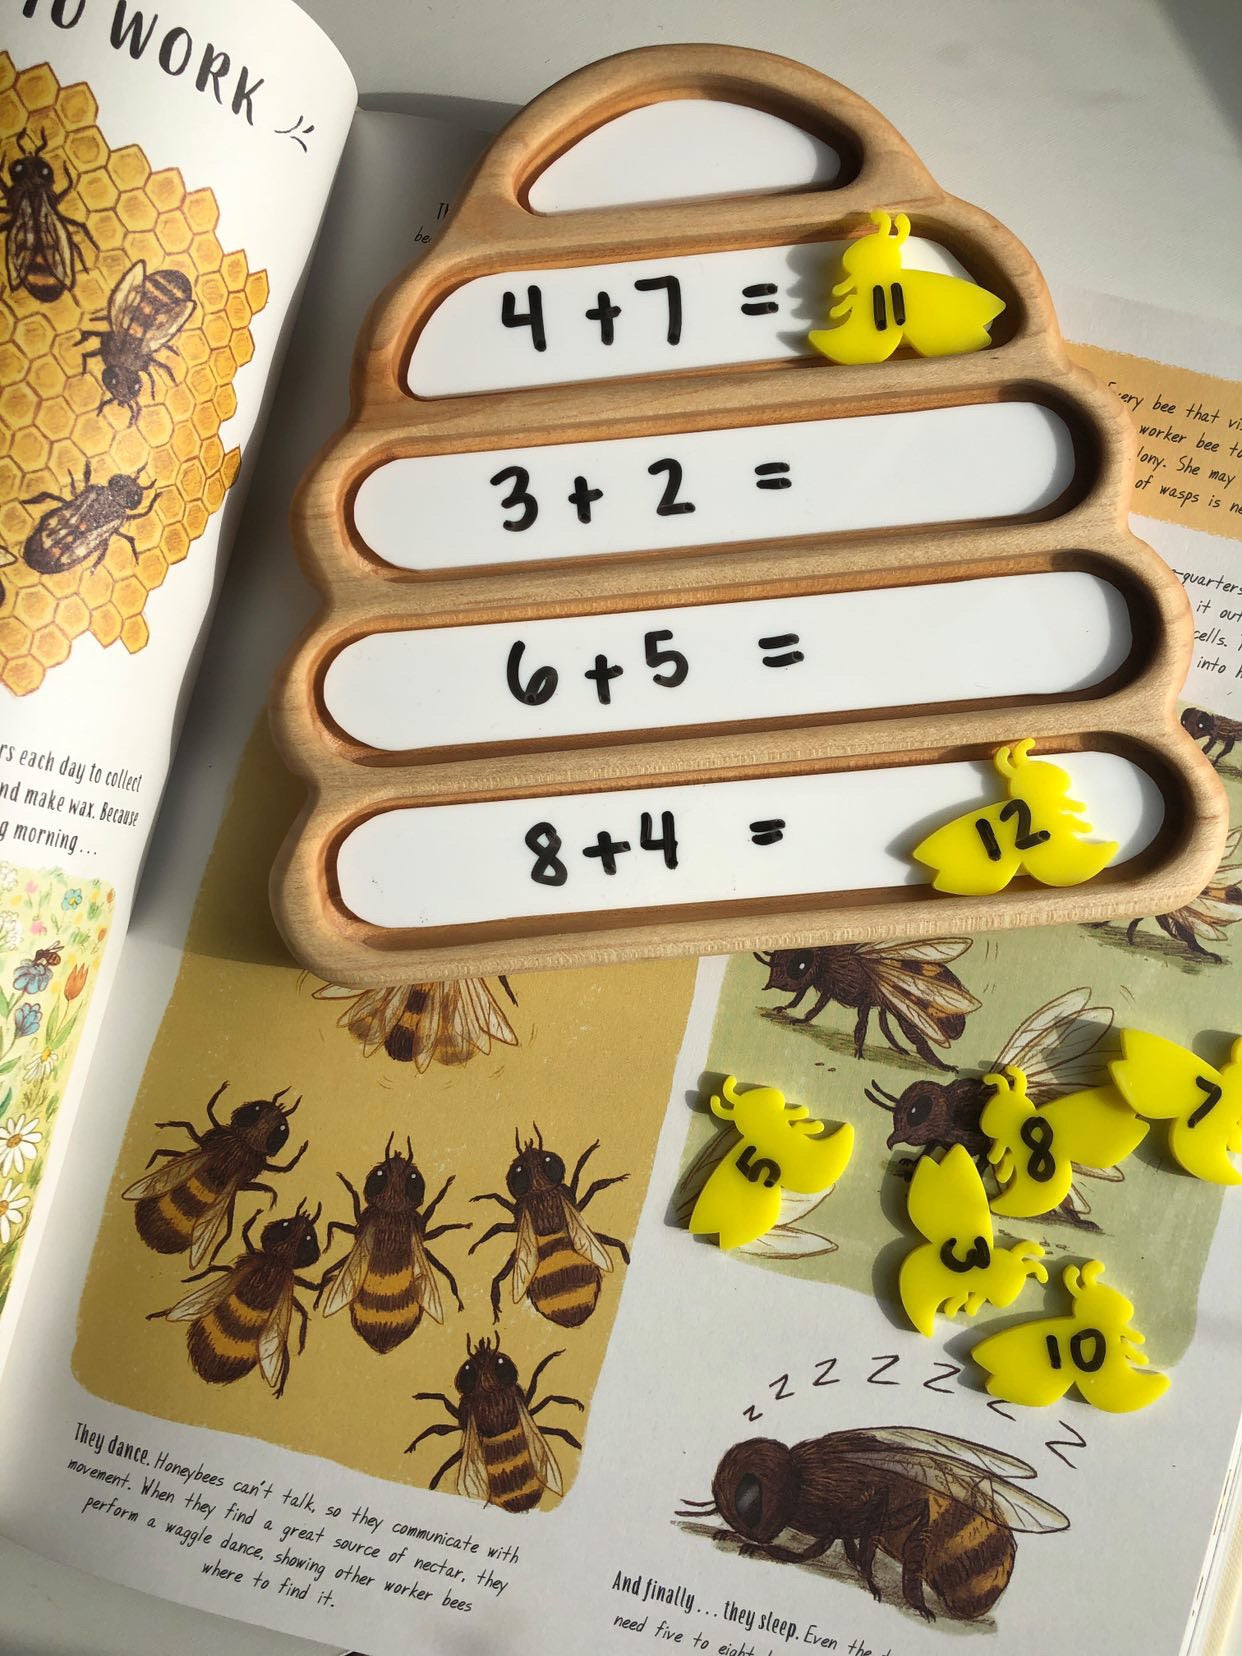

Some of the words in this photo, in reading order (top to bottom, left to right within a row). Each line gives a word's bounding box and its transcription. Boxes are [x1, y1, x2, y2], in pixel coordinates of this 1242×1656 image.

[110, 0, 264, 126] WORK
[872, 282, 906, 331] 11
[1152, 393, 1177, 414] bee
[1185, 403, 1221, 424] that
[1139, 424, 1187, 443] worker
[1196, 432, 1220, 452] bee
[1135, 475, 1154, 490] of
[1159, 485, 1200, 507] wasps
[1208, 495, 1221, 508] is
[1176, 456, 1201, 475] She
[1208, 469, 1236, 489] may
[490, 466, 538, 532] 3
[647, 458, 696, 516] 2
[1196, 599, 1211, 614] it
[1193, 627, 1228, 647] cells.
[1197, 656, 1227, 674] into
[19, 750, 55, 772] each
[59, 755, 86, 785] day
[89, 763, 102, 784] to
[105, 769, 142, 793] collect
[24, 789, 65, 812] make
[69, 798, 95, 819] wax.
[99, 801, 139, 827] Because
[975, 799, 1051, 861] 12
[1186, 1076, 1221, 1129] 7
[735, 1145, 782, 1188] 5
[1020, 1116, 1055, 1183] 8
[939, 1236, 991, 1273] 3
[1045, 1327, 1107, 1373] 10
[74, 1422, 104, 1454] They
[107, 1435, 150, 1466] dance.
[153, 1451, 225, 1487] Honeybees
[233, 1480, 273, 1499] can't
[282, 1488, 315, 1514] talk,
[325, 1506, 342, 1518] so
[352, 1506, 384, 1534] they
[392, 1522, 480, 1554] communicate
[488, 1545, 520, 1564] with
[67, 1458, 132, 1490] movement.
[140, 1476, 175, 1504] When
[185, 1493, 217, 1520] they
[224, 1502, 258, 1525] find
[263, 1519, 272, 1530] a
[279, 1524, 325, 1543] great
[333, 1537, 381, 1558] source
[388, 1547, 409, 1564] of
[414, 1556, 466, 1582] nectar,
[477, 1569, 509, 1597] they
[81, 1496, 139, 1522] perform
[147, 1517, 156, 1528] a
[165, 1522, 212, 1547] waggle
[220, 1532, 264, 1560] dance,
[273, 1547, 327, 1582] showing
[335, 1565, 376, 1586] other
[384, 1581, 434, 1602] worker
[441, 1588, 473, 1612] bees
[201, 1558, 244, 1583] where
[252, 1571, 270, 1590] to
[280, 1577, 311, 1600] find
[317, 1589, 336, 1608] it.
[612, 1570, 642, 1596] And
[723, 1600, 756, 1631] they
[758, 1611, 799, 1642] sleep.
[803, 1624, 838, 1650] Even
[847, 1639, 873, 1656] the
[613, 1615, 649, 1632] need
[654, 1620, 684, 1642] five
[693, 1631, 710, 1650] to
